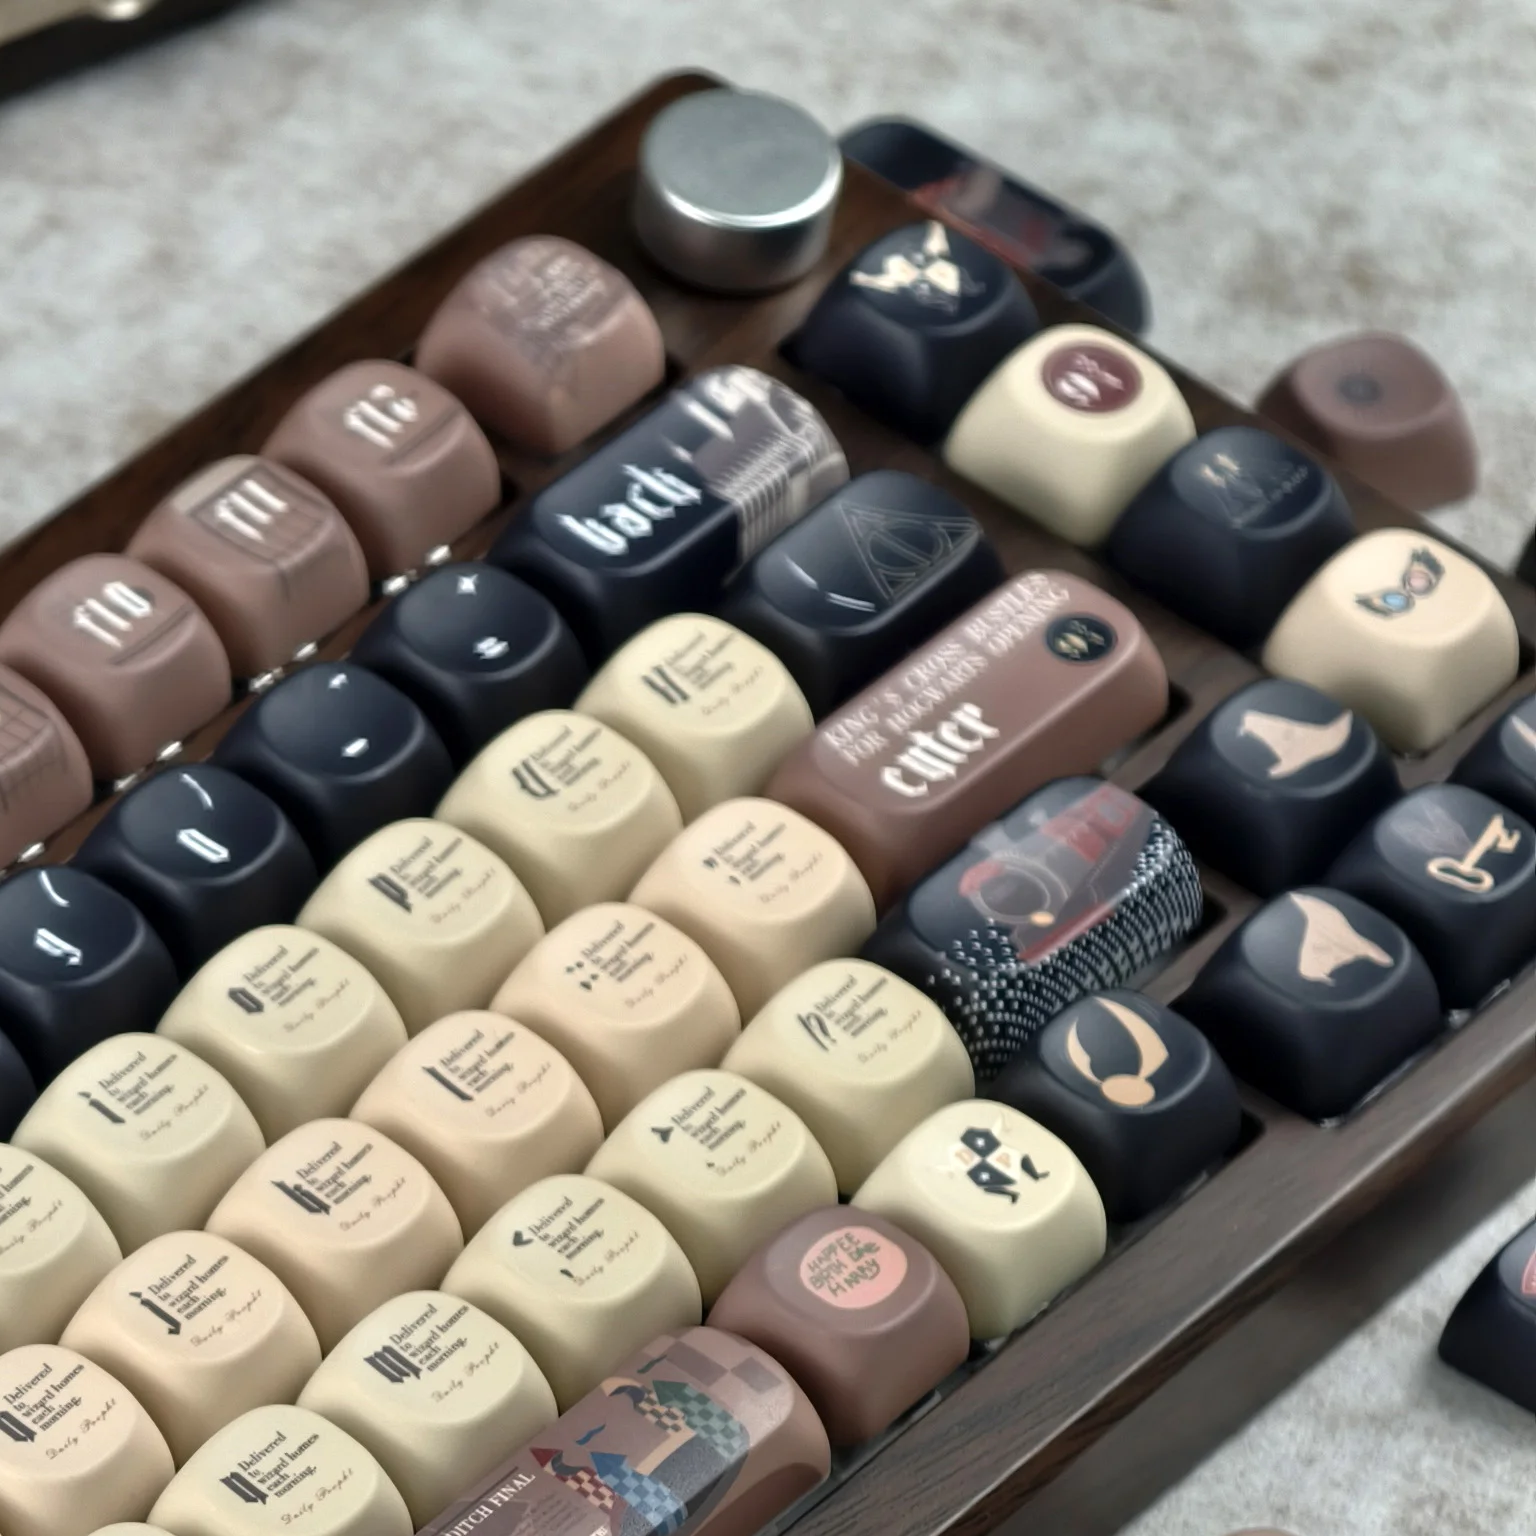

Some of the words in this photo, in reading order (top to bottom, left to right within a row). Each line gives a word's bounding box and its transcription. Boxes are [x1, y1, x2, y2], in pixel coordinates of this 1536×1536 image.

[903, 641, 964, 690] CROSS
[843, 730, 891, 767] FOR
[886, 654, 988, 735] HOGWARTS
[389, 1302, 438, 1345] Delivered
[409, 1330, 440, 1357] wizard
[436, 1305, 469, 1333] homes
[488, 1473, 536, 1507] FINAL
